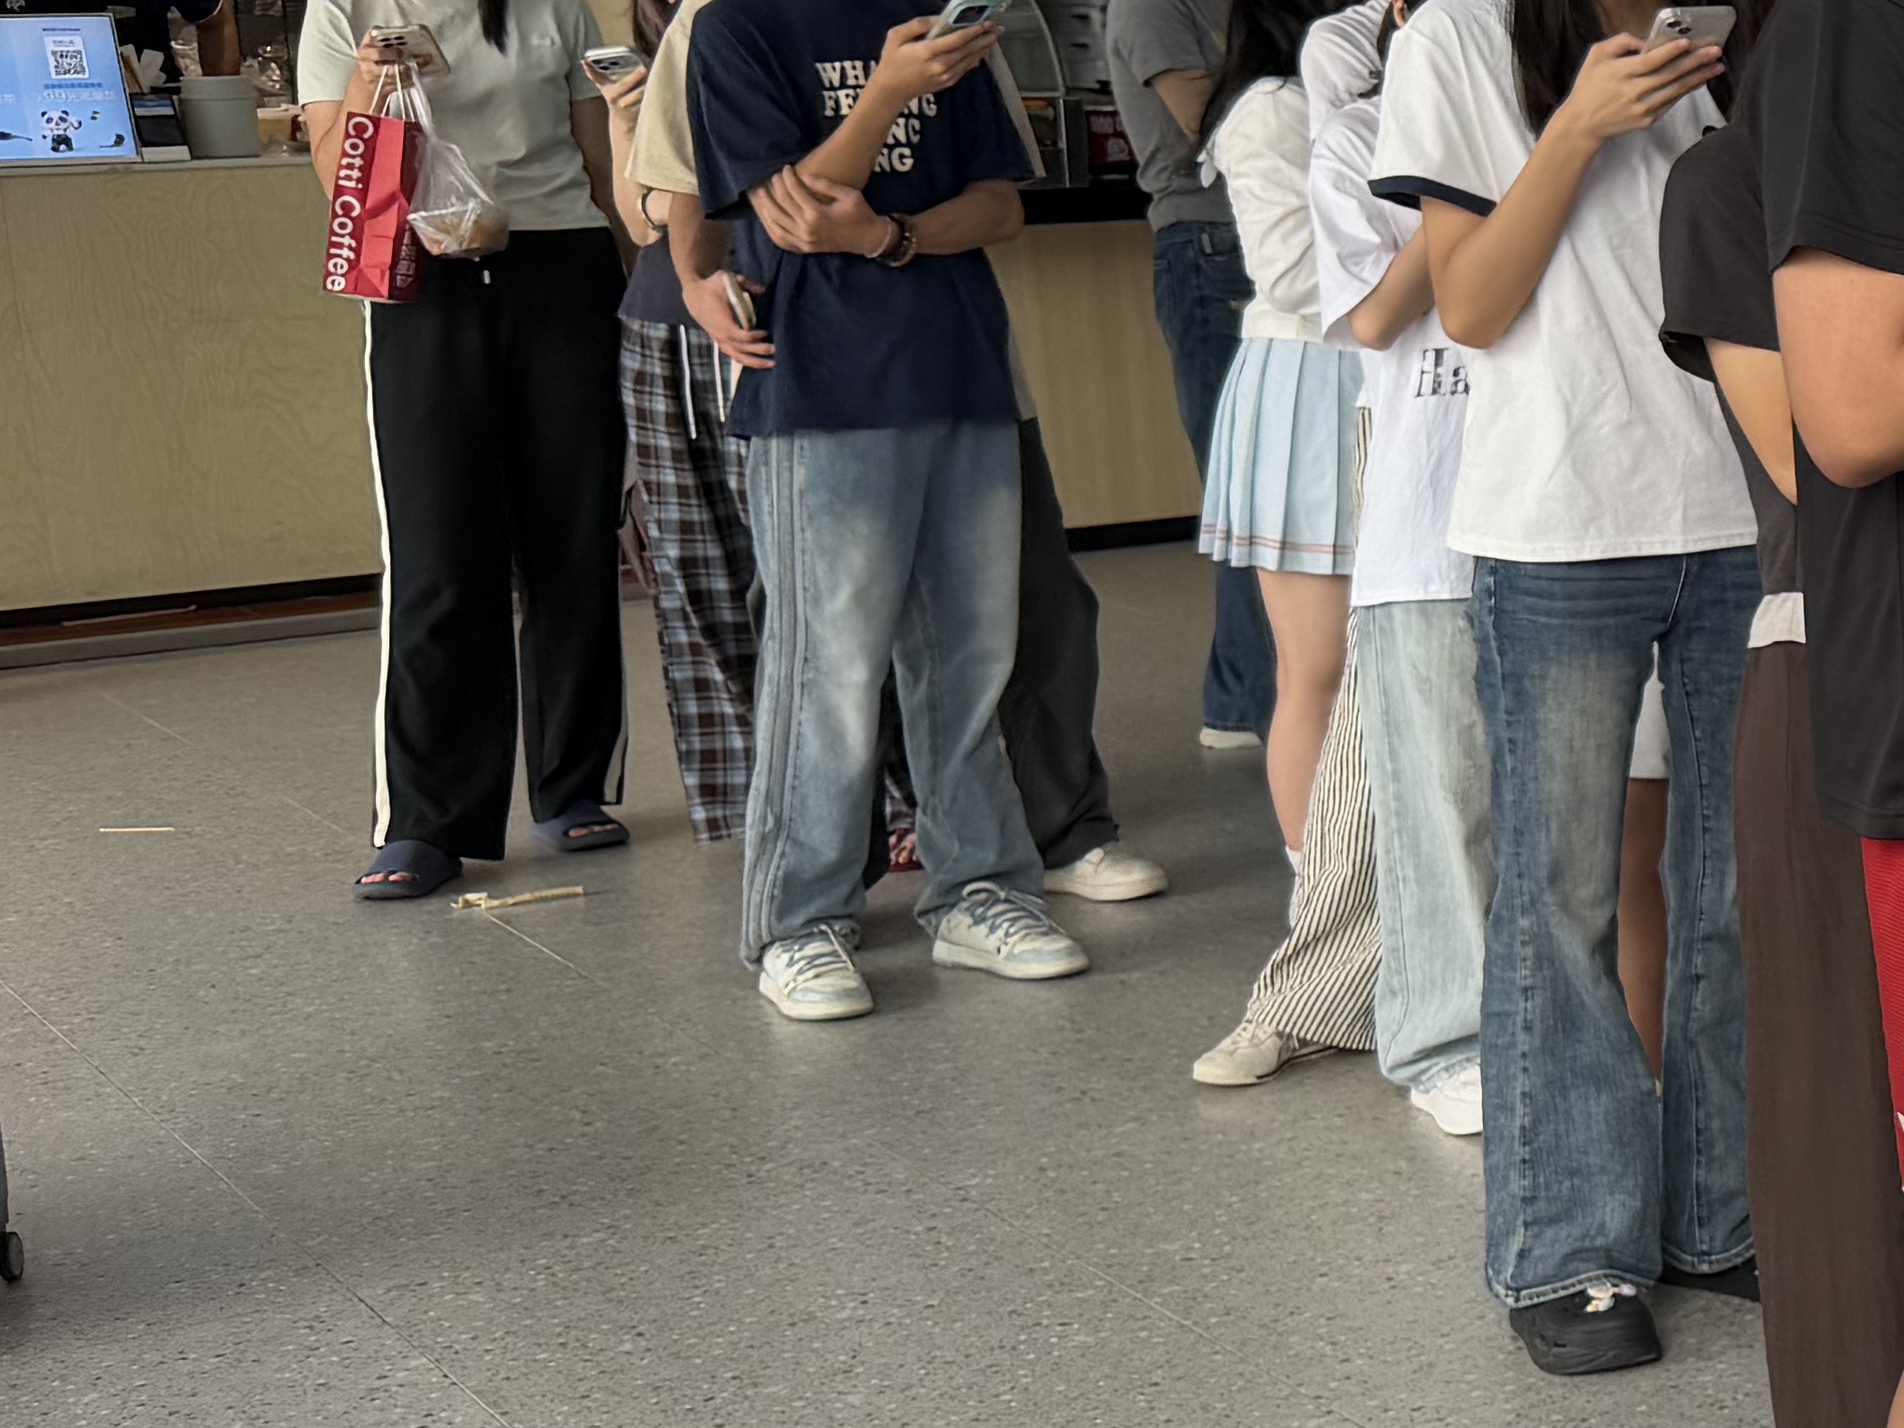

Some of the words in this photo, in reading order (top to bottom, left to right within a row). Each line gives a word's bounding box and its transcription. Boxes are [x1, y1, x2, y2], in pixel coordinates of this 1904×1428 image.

[815, 60, 880, 88] WH
[338, 116, 374, 189] Cotti
[874, 146, 914, 172] NG
[326, 195, 362, 292] Coffee
